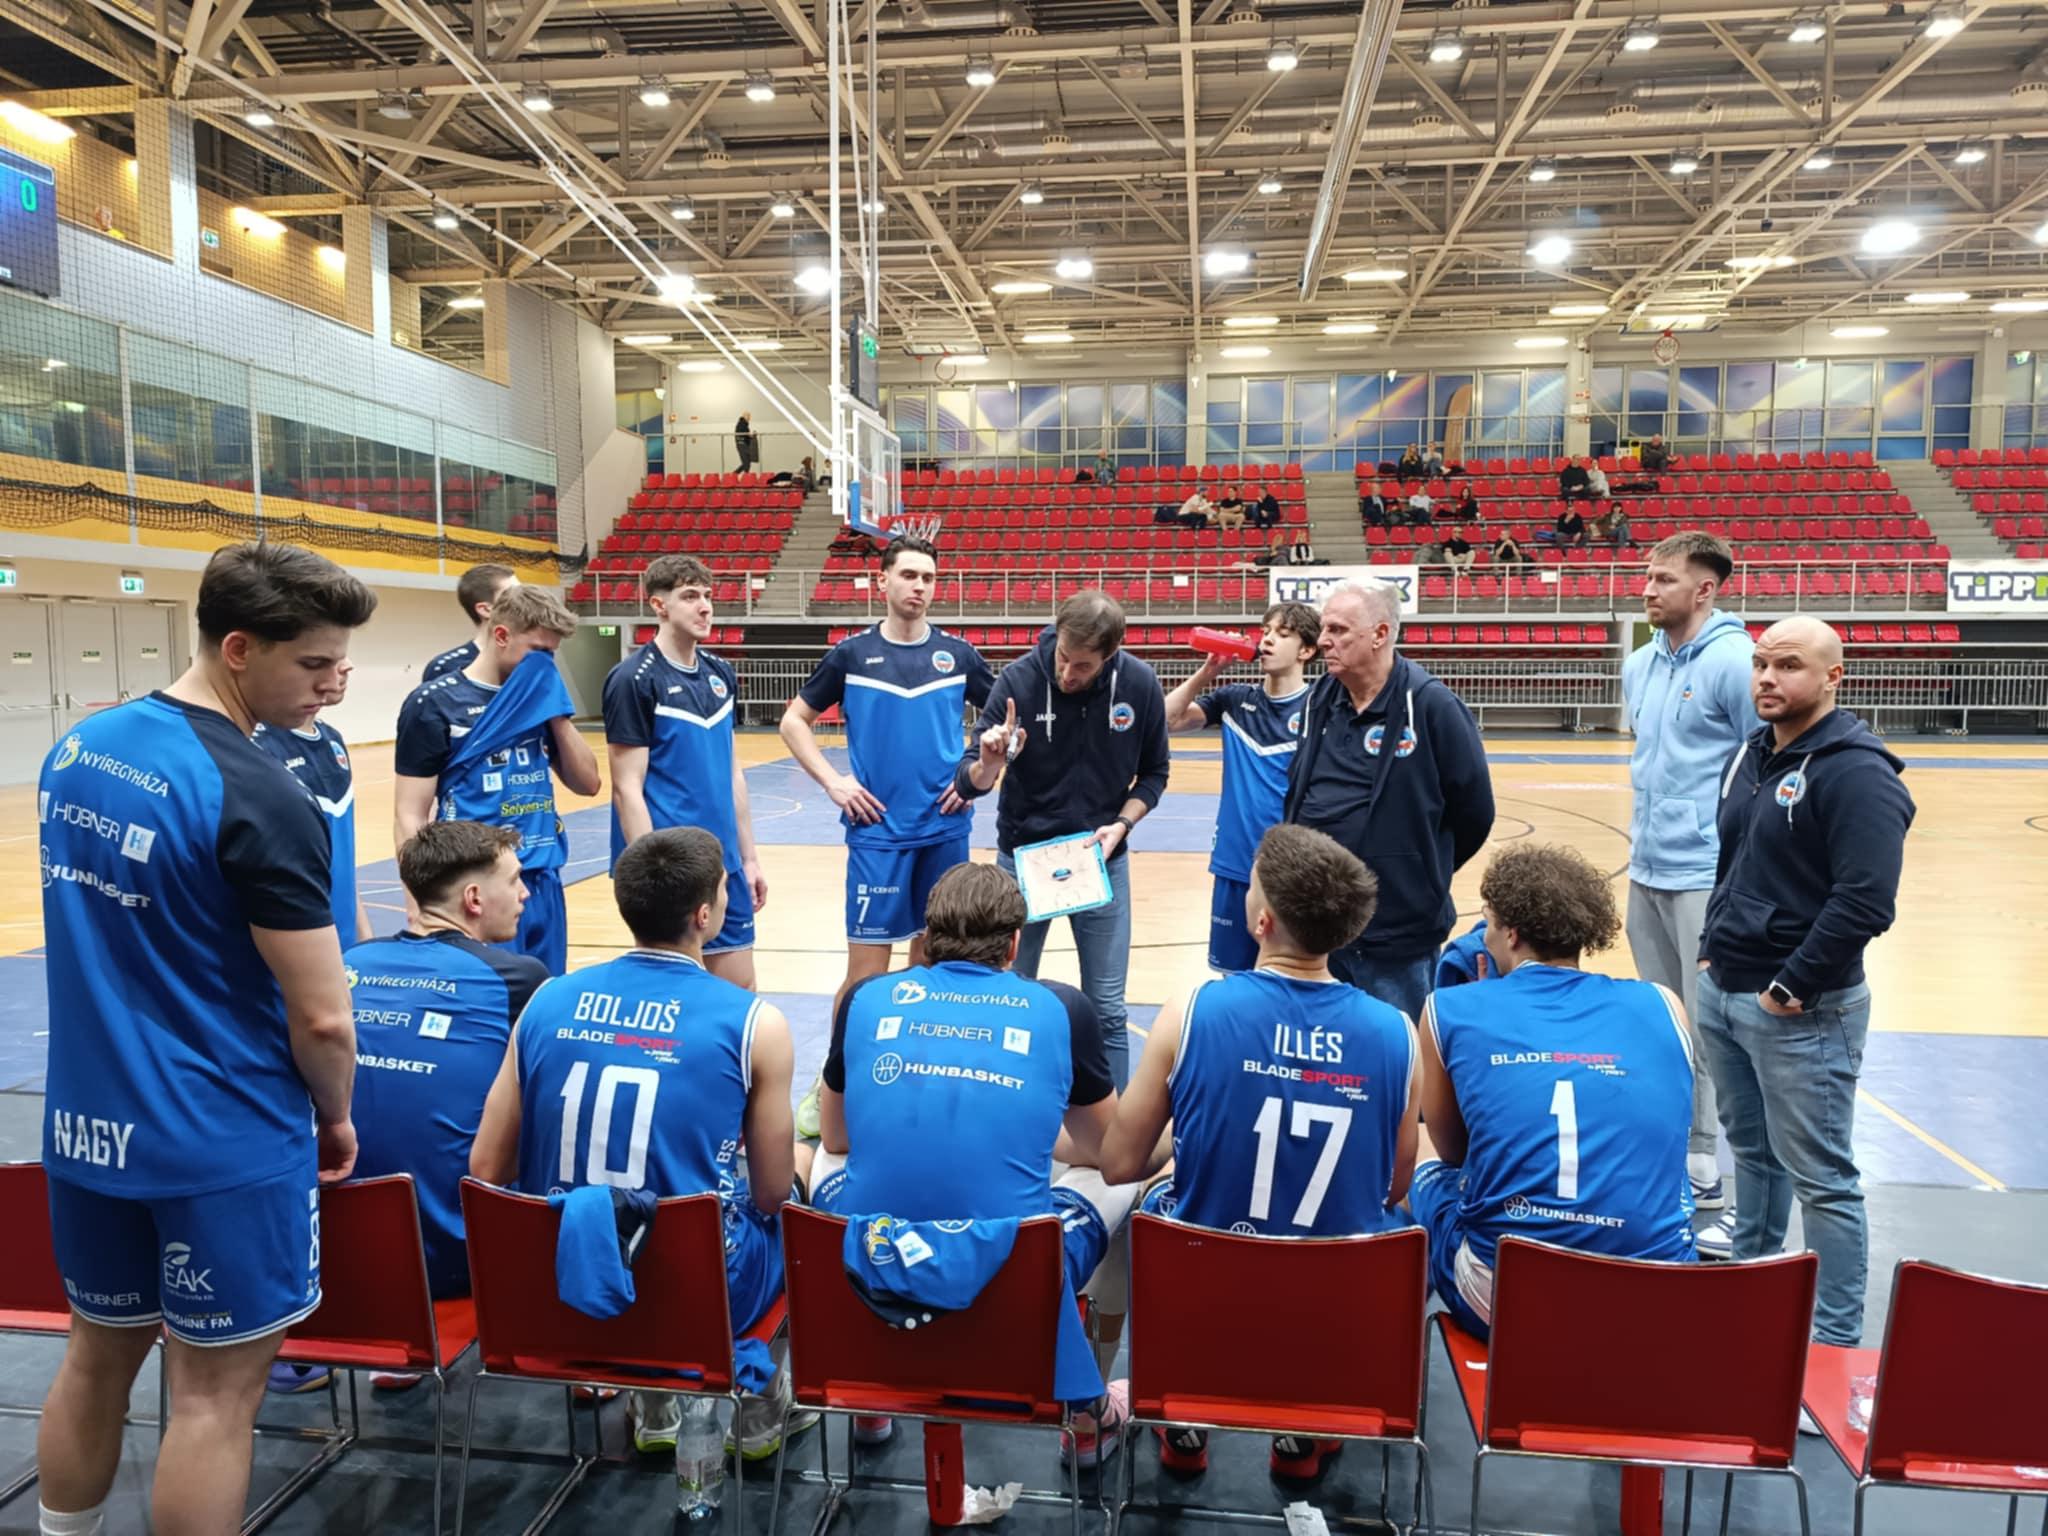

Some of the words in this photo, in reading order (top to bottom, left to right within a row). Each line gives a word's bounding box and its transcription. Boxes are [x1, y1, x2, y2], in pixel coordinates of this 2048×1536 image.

[21, 178, 37, 212] 0
[79, 750, 169, 798] NYÍREGYHÁZA
[52, 801, 121, 842] HÜBNER
[857, 896, 870, 924] 7
[360, 974, 457, 994] NYÍREGYHÁZA
[574, 992, 681, 1033] BOLJOŠ
[929, 990, 1030, 1009] NYÍREGYHÁZA
[556, 1028, 676, 1051] BLADESPORT
[908, 1021, 993, 1043] HÜBNER
[1274, 1023, 1343, 1064] ILLÉS
[1490, 1051, 1615, 1066] BLADESPORT
[904, 1062, 1025, 1090] HUNBASKET
[1243, 1060, 1363, 1088] BLADESPORT
[559, 1060, 660, 1190] 10
[54, 1109, 135, 1170] NAGY
[1550, 1080, 1579, 1200] 1
[1249, 1096, 1353, 1228] 17
[1531, 1206, 1626, 1229] HUNBASKET
[210, 1316, 233, 1329] FM
